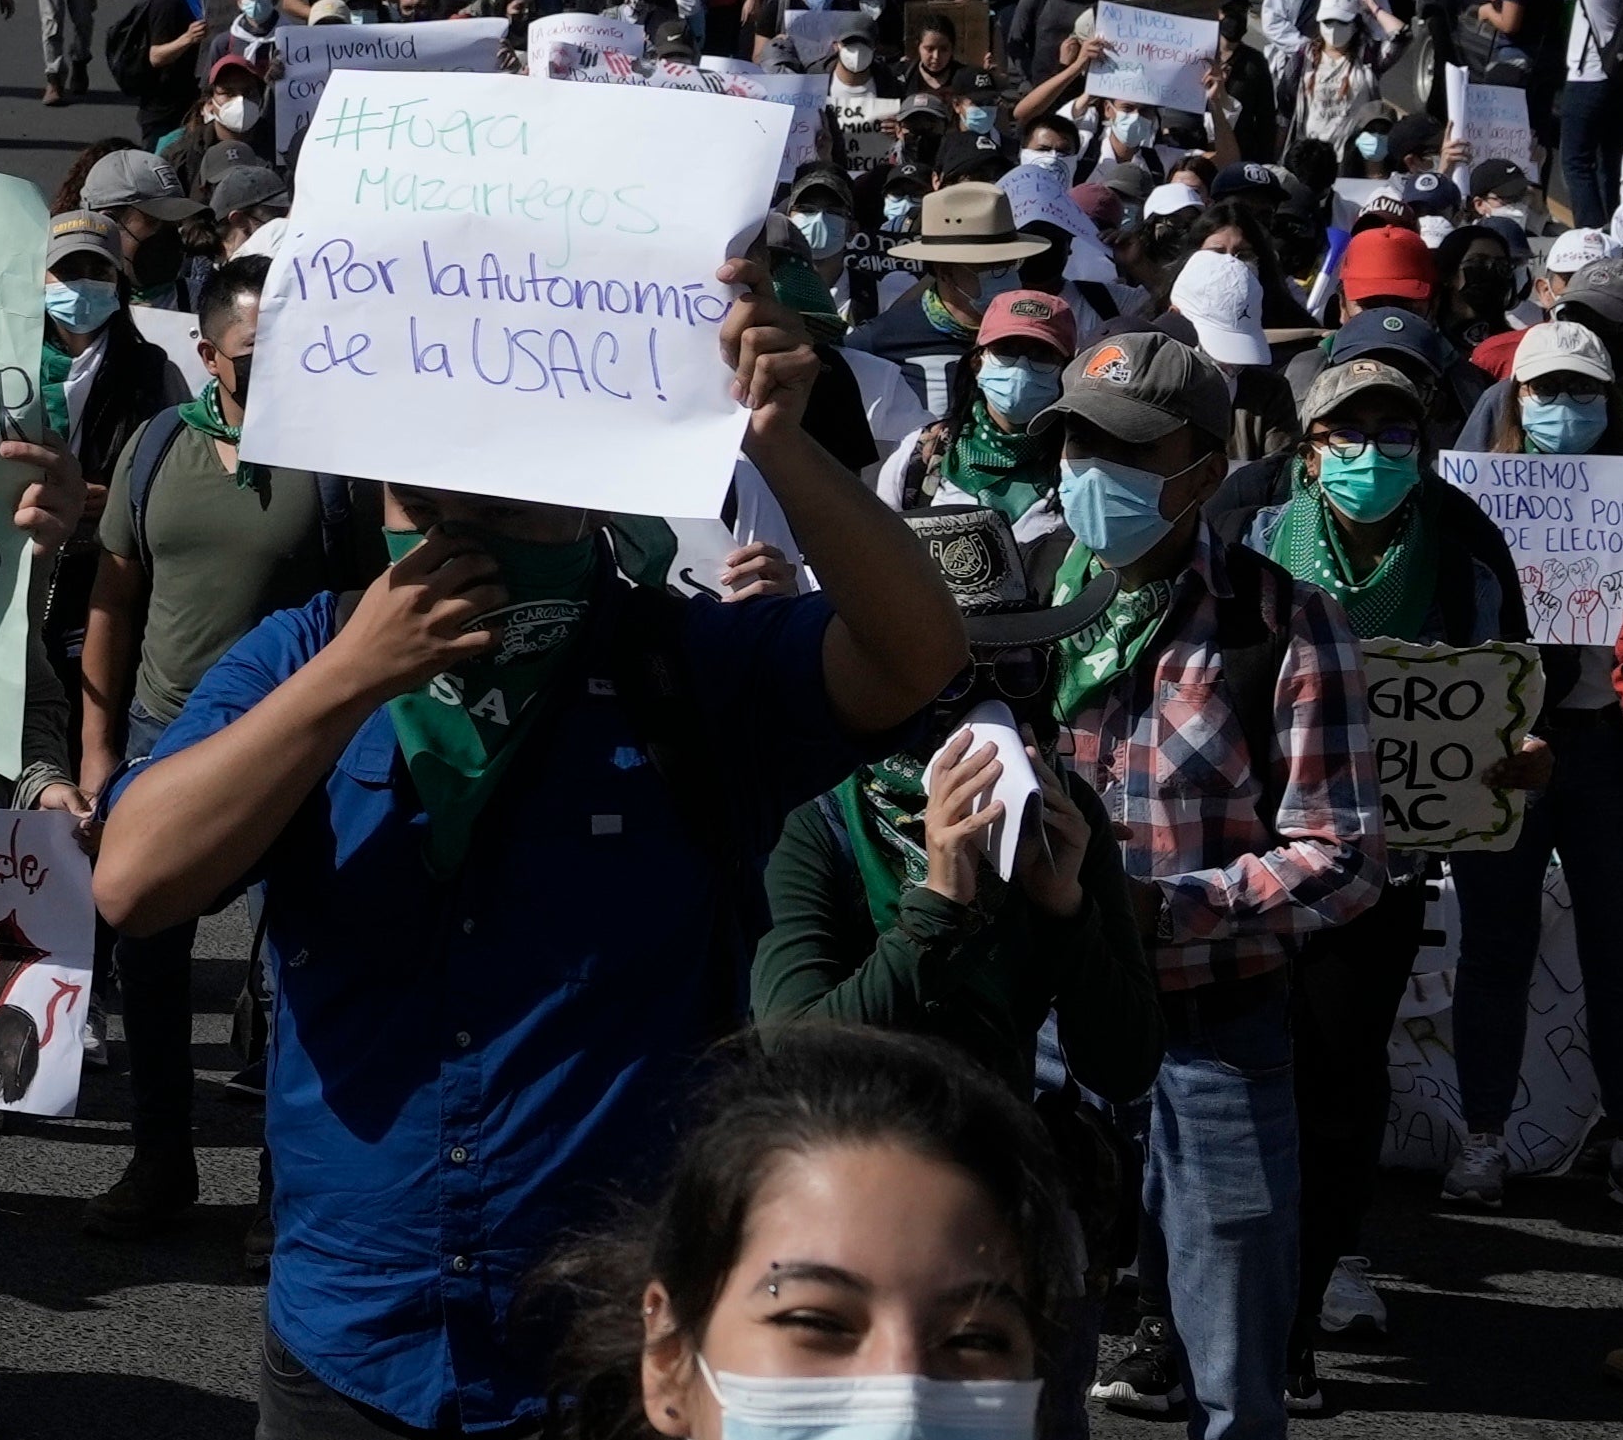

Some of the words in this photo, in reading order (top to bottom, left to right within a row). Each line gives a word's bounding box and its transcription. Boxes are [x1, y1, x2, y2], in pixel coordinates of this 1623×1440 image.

[315, 97, 529, 159] #Fuera
[299, 324, 379, 377] de
[410, 316, 456, 379] la
[1443, 456, 1478, 485] NO
[1490, 459, 1591, 493] SEREMOS
